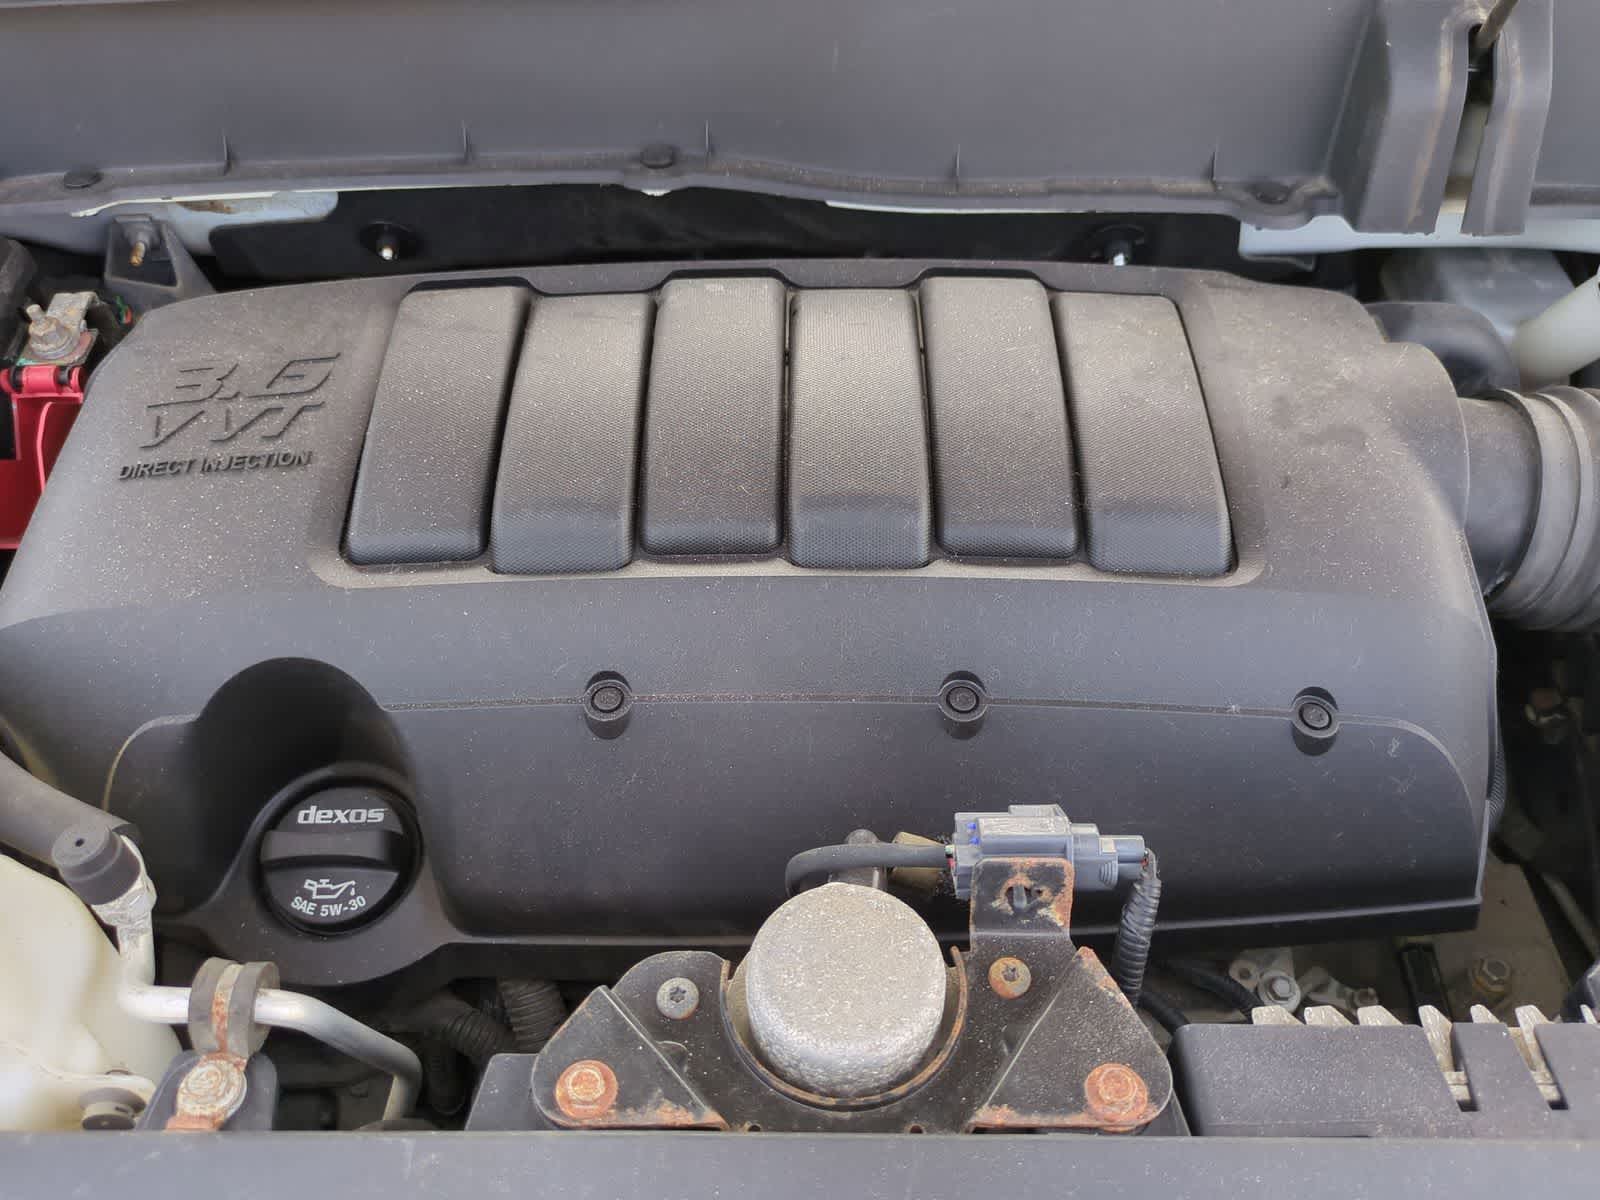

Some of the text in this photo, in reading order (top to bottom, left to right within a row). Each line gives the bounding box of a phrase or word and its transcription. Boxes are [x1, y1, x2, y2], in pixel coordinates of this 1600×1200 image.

[148, 352, 341, 408] 3.6
[139, 401, 325, 449] VVT
[119, 451, 313, 480] DIRECT INJECTION
[297, 805, 386, 824] dexos
[290, 895, 366, 917] SAE 5W-30
